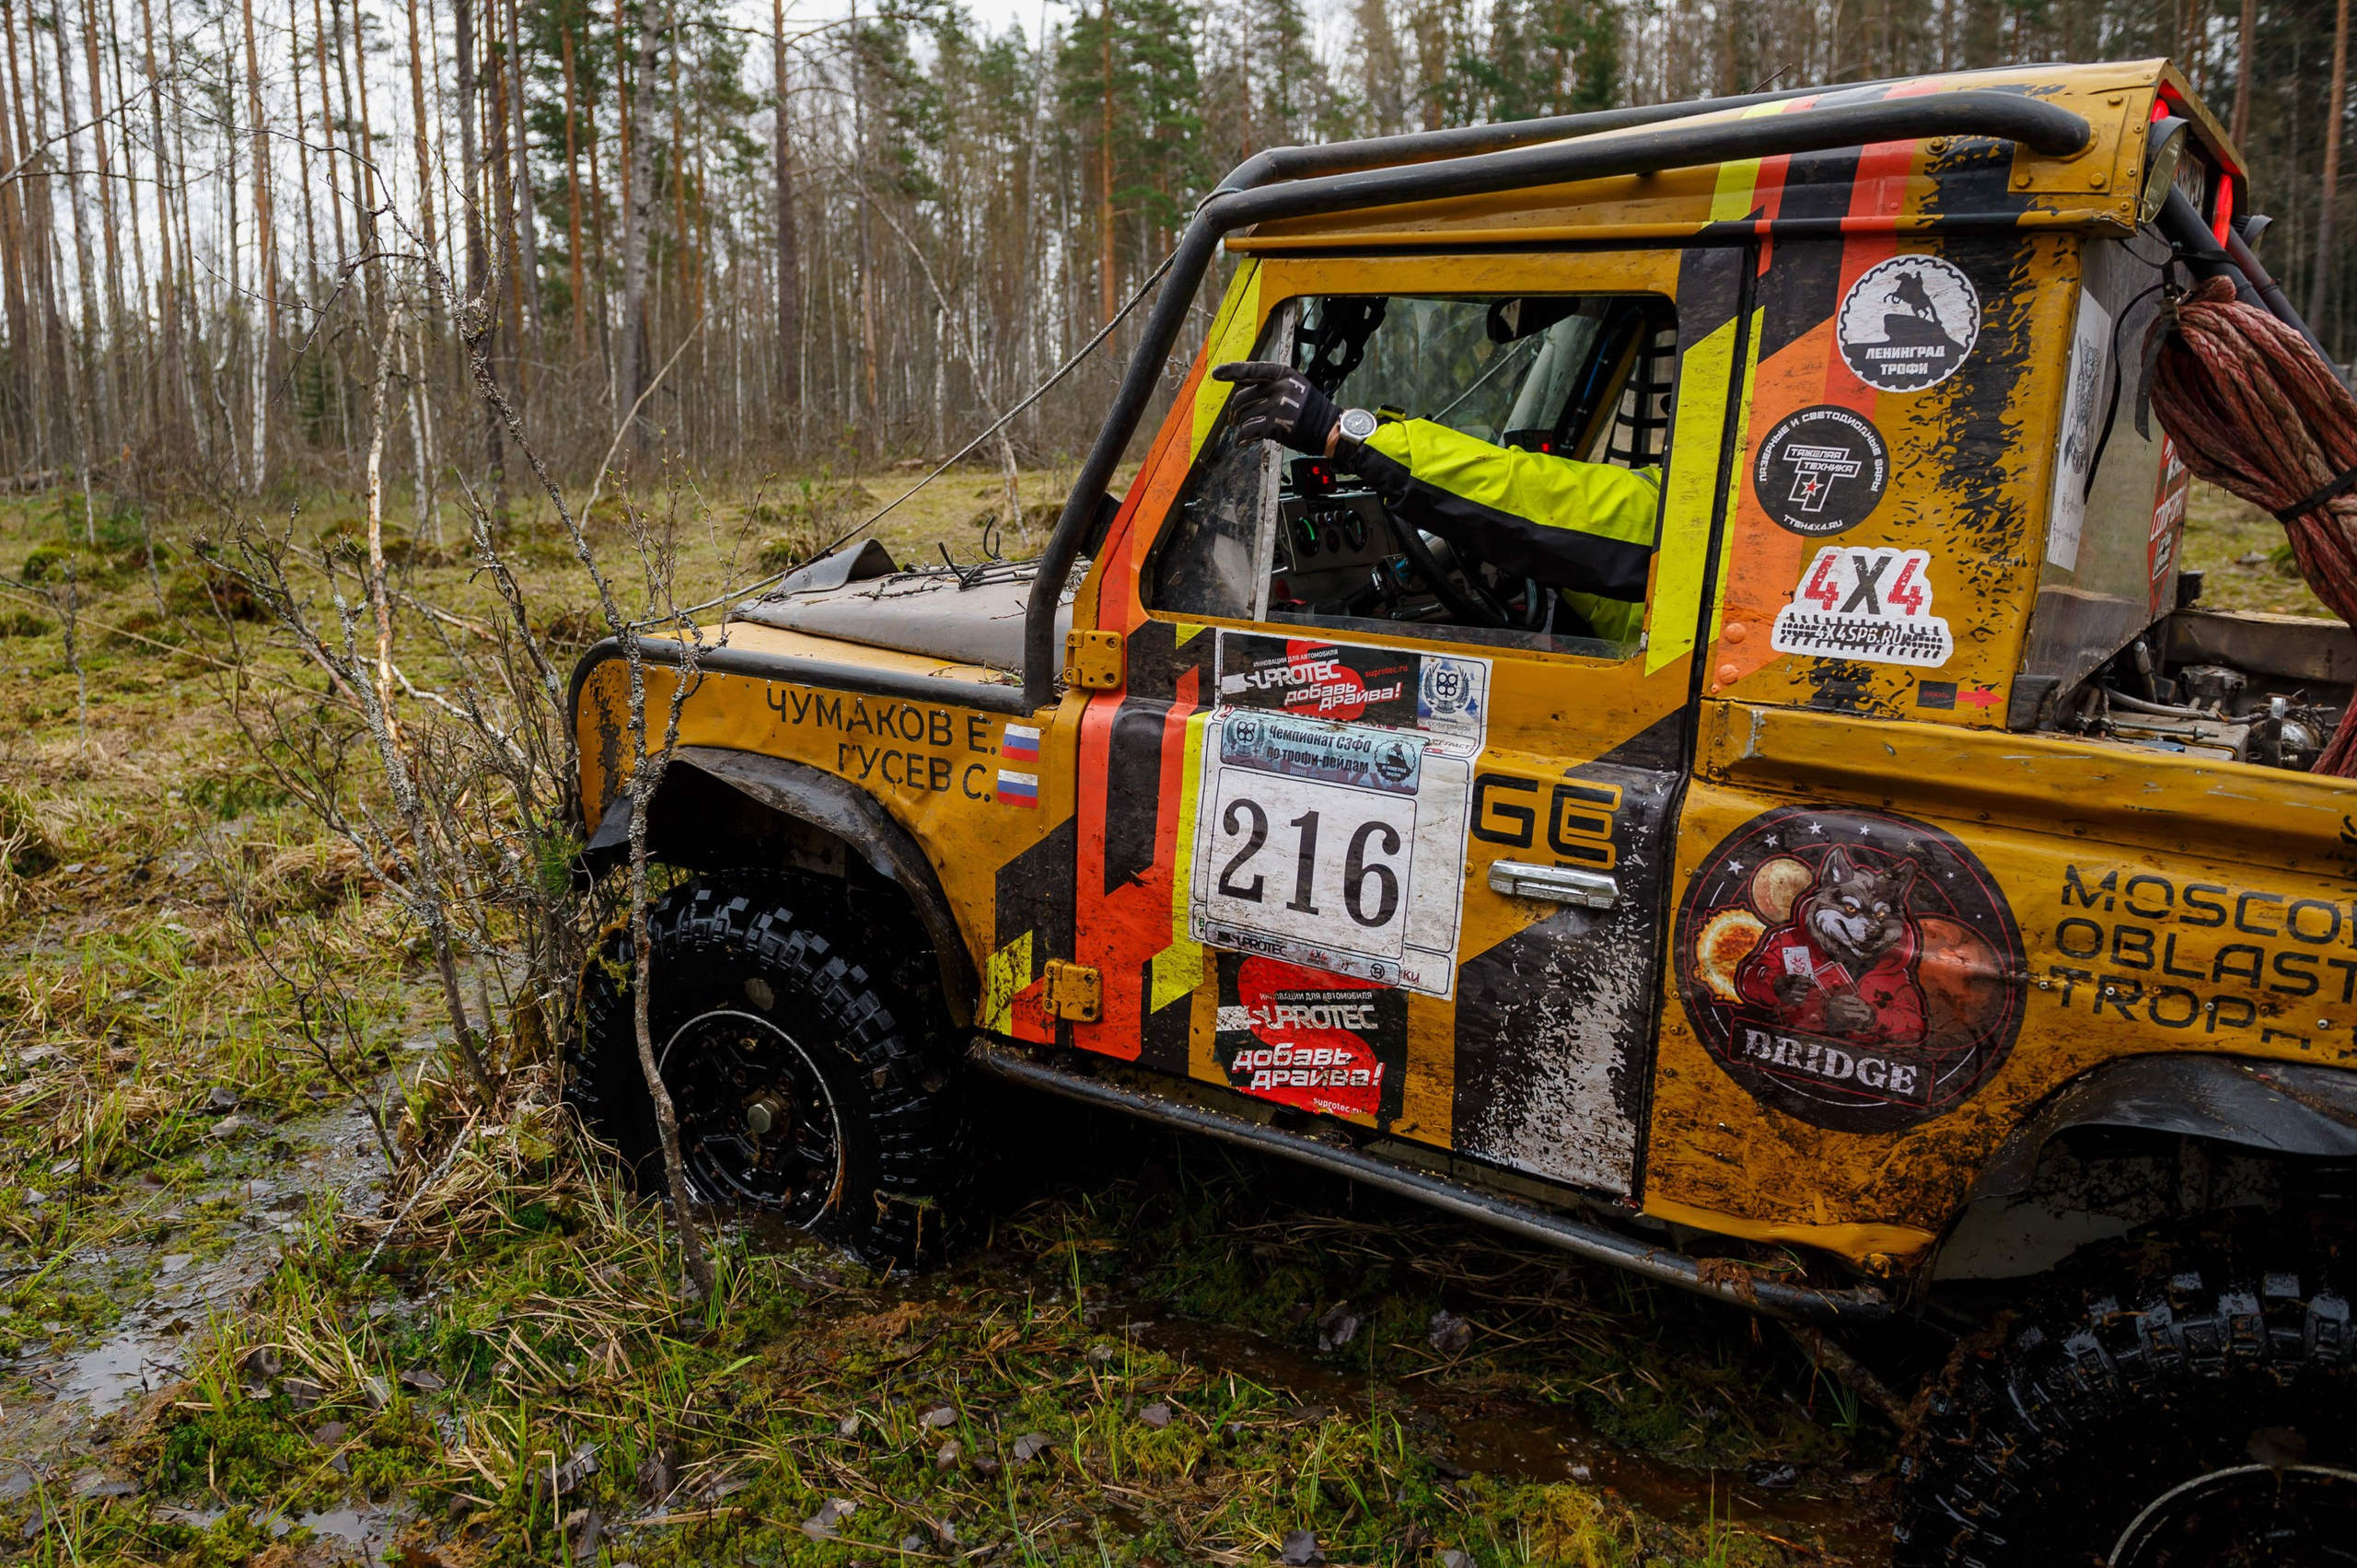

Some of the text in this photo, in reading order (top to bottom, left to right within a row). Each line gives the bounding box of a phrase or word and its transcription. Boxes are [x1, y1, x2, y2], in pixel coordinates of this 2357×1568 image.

[1865, 345, 1945, 360] ЛЕНИНГРАД
[1880, 363, 1928, 376] ТРОФИ
[1759, 424, 1791, 482] ЛАЗЕРНЫЕ
[1791, 419, 1800, 428] И
[1802, 411, 1882, 457] СВЕТОДИОДНЫЕ
[1790, 447, 1843, 459] ТЯЖЕЛАЯ
[1804, 461, 1854, 473] ТЕХНИКА
[1804, 554, 1923, 616] 4X4
[1816, 623, 1903, 646] 4X4SPB.RU
[1253, 648, 1339, 668] ИННОВАЦИИ ДЛЯ АВТОМОБИЛЯ
[1364, 665, 1409, 679] suprotec.ru
[1238, 659, 1341, 691] SUPROTEC
[1284, 682, 1357, 707] добавь
[1318, 681, 1401, 712] драйва!
[766, 687, 997, 755] ЧУМАКОВ Е.
[1270, 725, 1372, 753] Чемпионат СЗФО
[838, 742, 991, 803] ГУСЕВ С.
[1267, 745, 1369, 774] по трофи-рейдам
[1218, 798, 1400, 927] 216
[2061, 864, 2357, 948] MOSCO
[1260, 992, 1373, 1002] ИНОВАЦИИ ДЛЯ АВТОМОБИЛЯ
[1243, 1005, 1378, 1030] SUPROTEC
[1232, 1042, 1353, 1071] добавь
[1743, 1028, 1917, 1096] BRIDGE
[1250, 1062, 1384, 1091] драйва!
